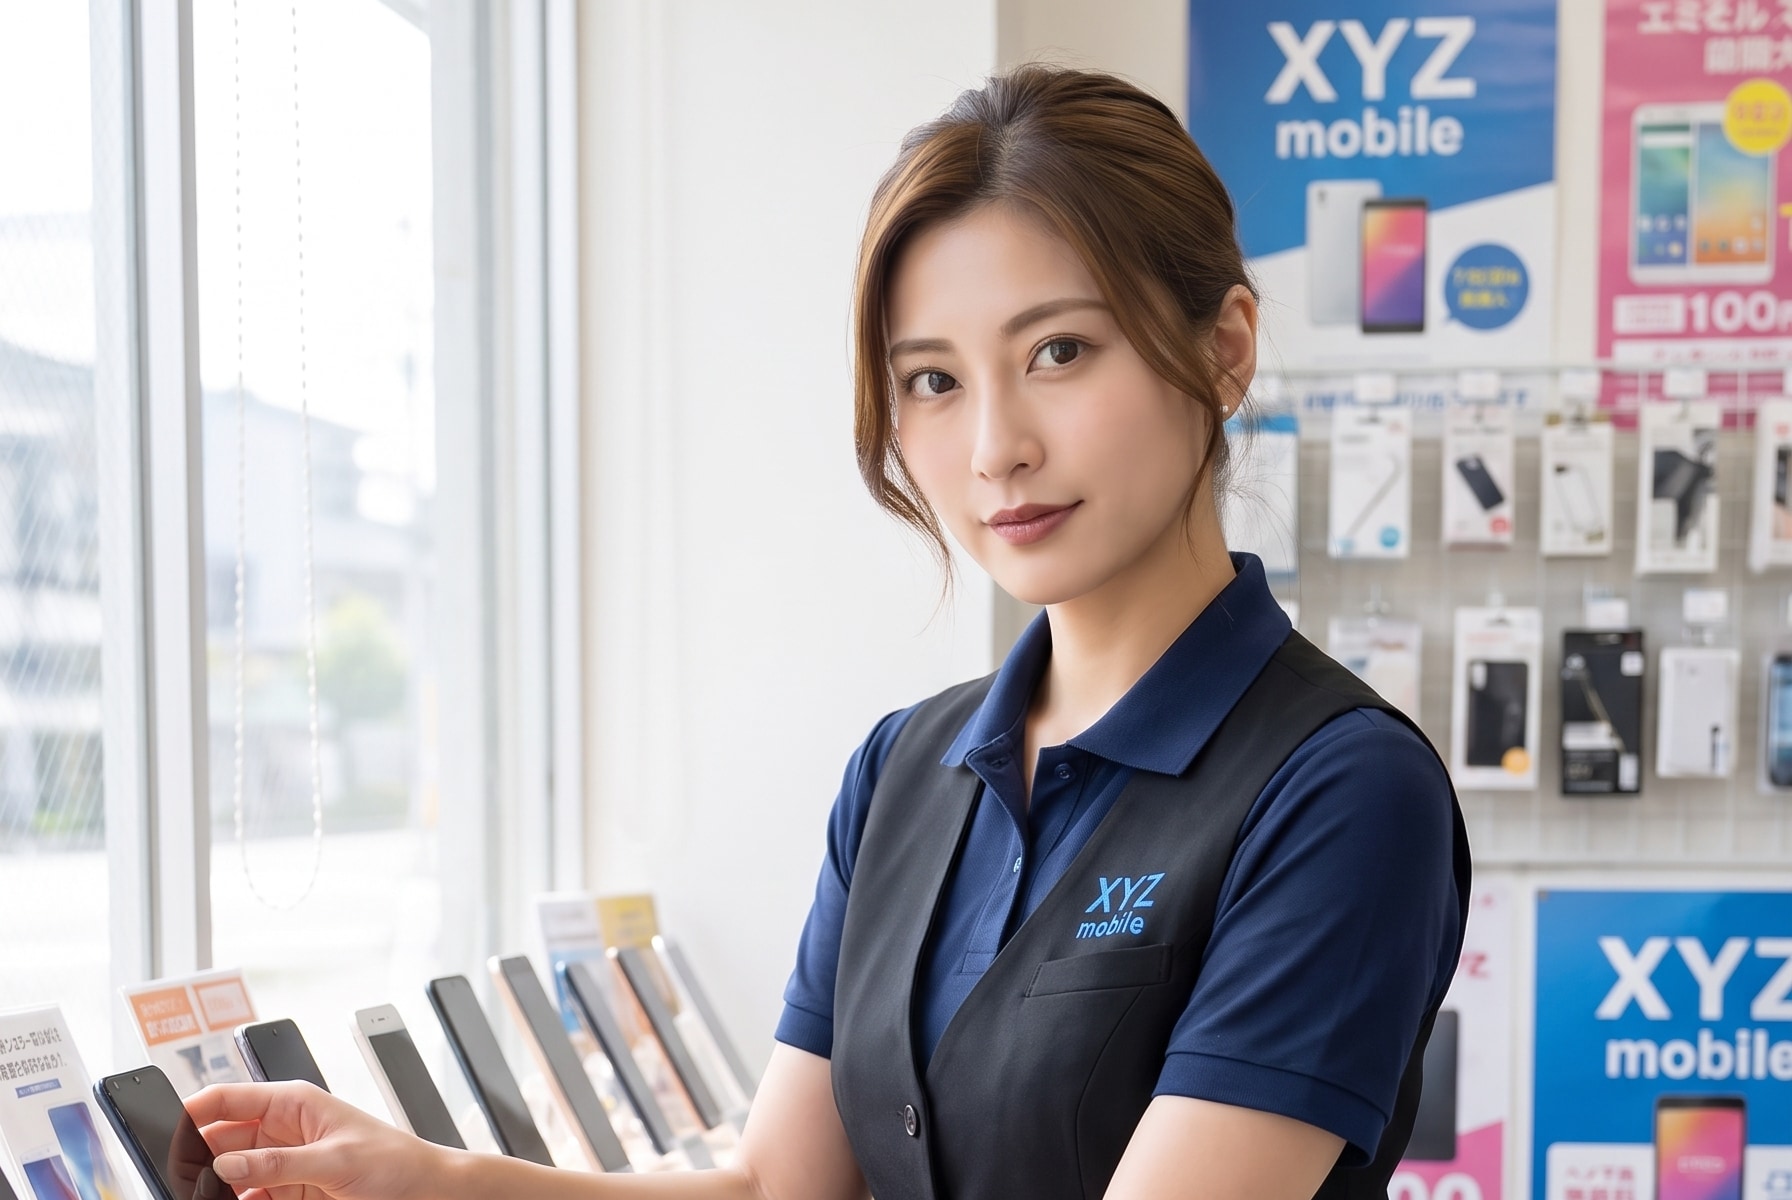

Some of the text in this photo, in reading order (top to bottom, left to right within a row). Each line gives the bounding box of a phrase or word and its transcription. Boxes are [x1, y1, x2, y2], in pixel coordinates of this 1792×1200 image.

[1264, 17, 1477, 103] XYZ
[1274, 106, 1465, 159] mobile
[1085, 872, 1166, 914] XYZ
[1075, 911, 1144, 939] mobile
[1594, 936, 1792, 1021] XYZ
[1605, 1028, 1792, 1081] mobile
